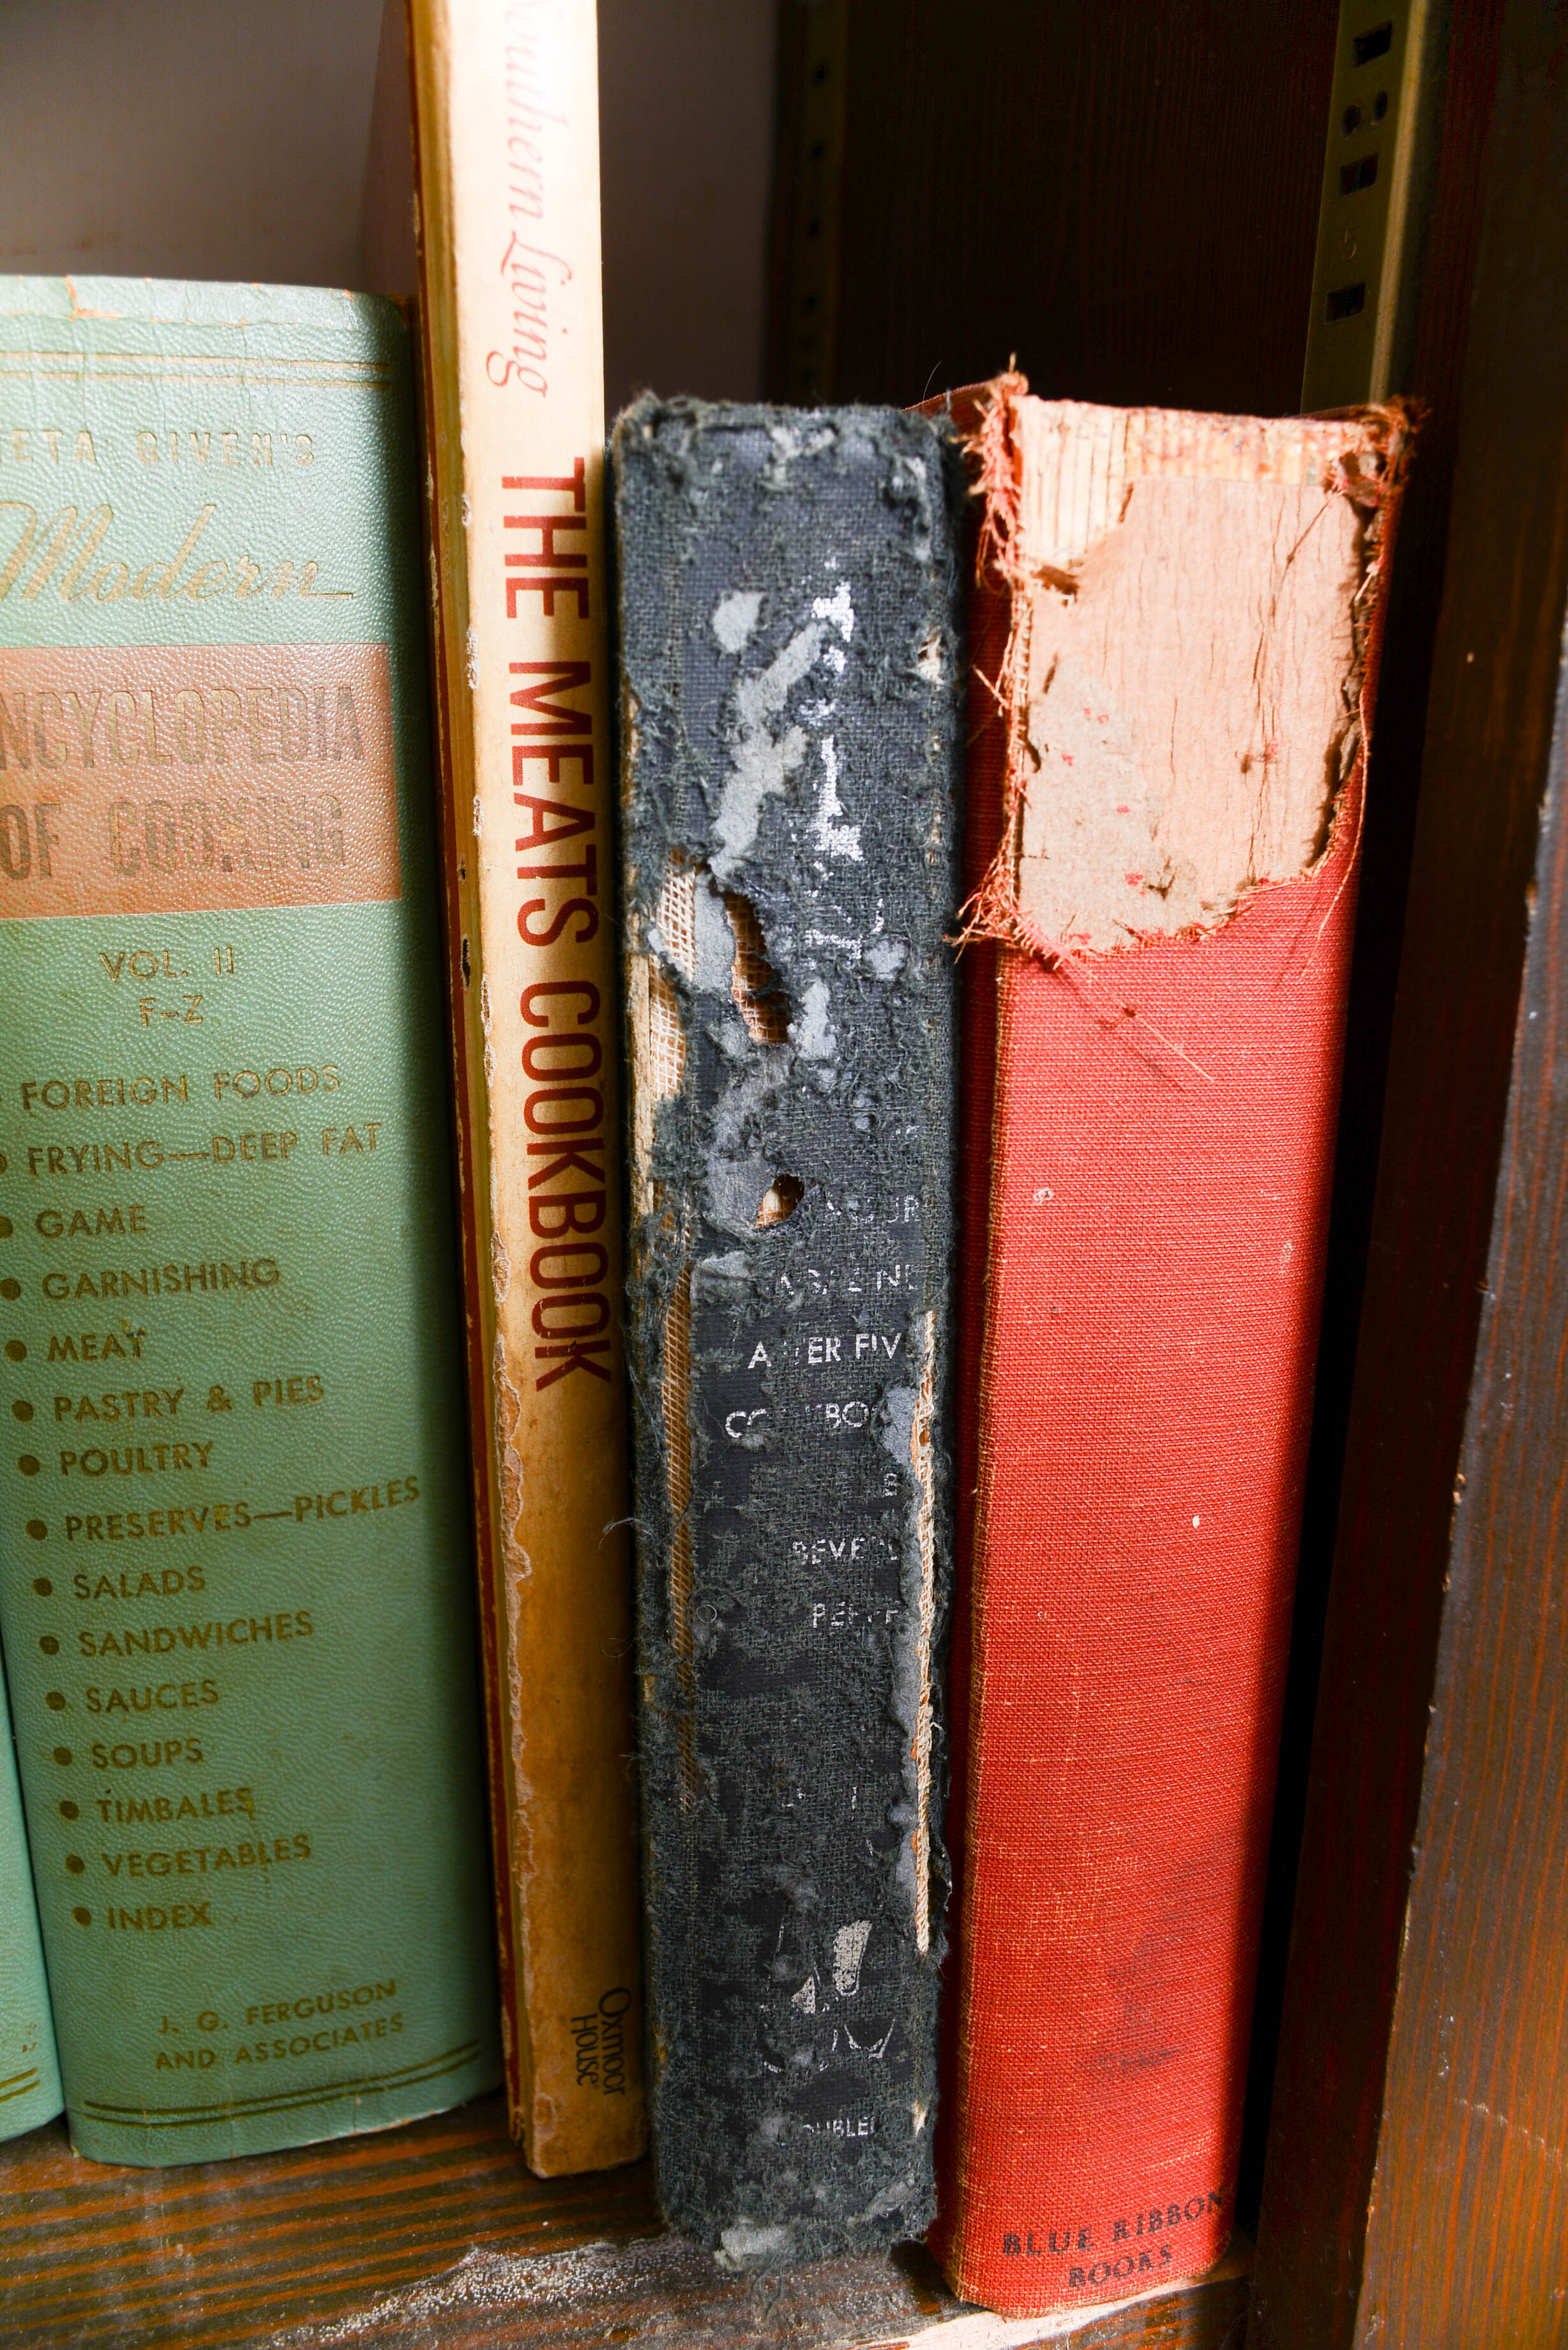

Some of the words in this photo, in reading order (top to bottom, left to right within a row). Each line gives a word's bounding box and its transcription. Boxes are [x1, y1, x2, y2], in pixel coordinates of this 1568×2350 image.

[504, 0, 572, 220] outhern
[486, 231, 573, 398] Living
[12, 428, 97, 464] ETA
[135, 430, 315, 466] GIVEN'S
[0, 501, 354, 603] Modern
[501, 456, 591, 619] THE
[0, 687, 364, 769] NCYCLOPEDIA
[508, 661, 601, 947] MEATS
[0, 803, 61, 881] OF
[107, 794, 346, 876] COOKING
[99, 951, 189, 982] VOL.
[213, 946, 234, 976] II
[20, 1075, 189, 1111] FOREIGN
[213, 1065, 340, 1100] FOODS
[320, 1122, 382, 1156] FAT
[520, 980, 613, 1393] COOKBOOK
[34, 1206, 147, 1239] GAME
[41, 1258, 281, 1301] GARNISHING
[47, 1330, 146, 1362] MEAT
[854, 1332, 903, 1360] FIV
[52, 1388, 185, 1423] PASTRY
[206, 1384, 234, 1413] &
[252, 1376, 324, 1408] PIES
[59, 1441, 215, 1477] POULTRY
[72, 1565, 207, 1601] SALADS
[79, 1610, 314, 1658] SANDWICHES
[85, 1679, 220, 1714] SAUCES
[91, 1738, 204, 1771] SOUPS
[96, 1787, 254, 1823] TIMBALES
[100, 1834, 312, 1877] VEGETABLES
[107, 1902, 211, 1932] INDEX
[157, 2015, 181, 2035] J.
[196, 2010, 229, 2033] G.
[246, 1979, 398, 2026] FERGUSON
[154, 2049, 216, 2072] AND
[234, 2013, 404, 2065] ASSOCIATES
[569, 2013, 601, 2087] House
[598, 1987, 633, 2096] Oxmoor
[1002, 2226, 1096, 2256] BLUE
[1112, 2186, 1225, 2243] RIBBON
[1068, 2243, 1173, 2289] BOOKS
